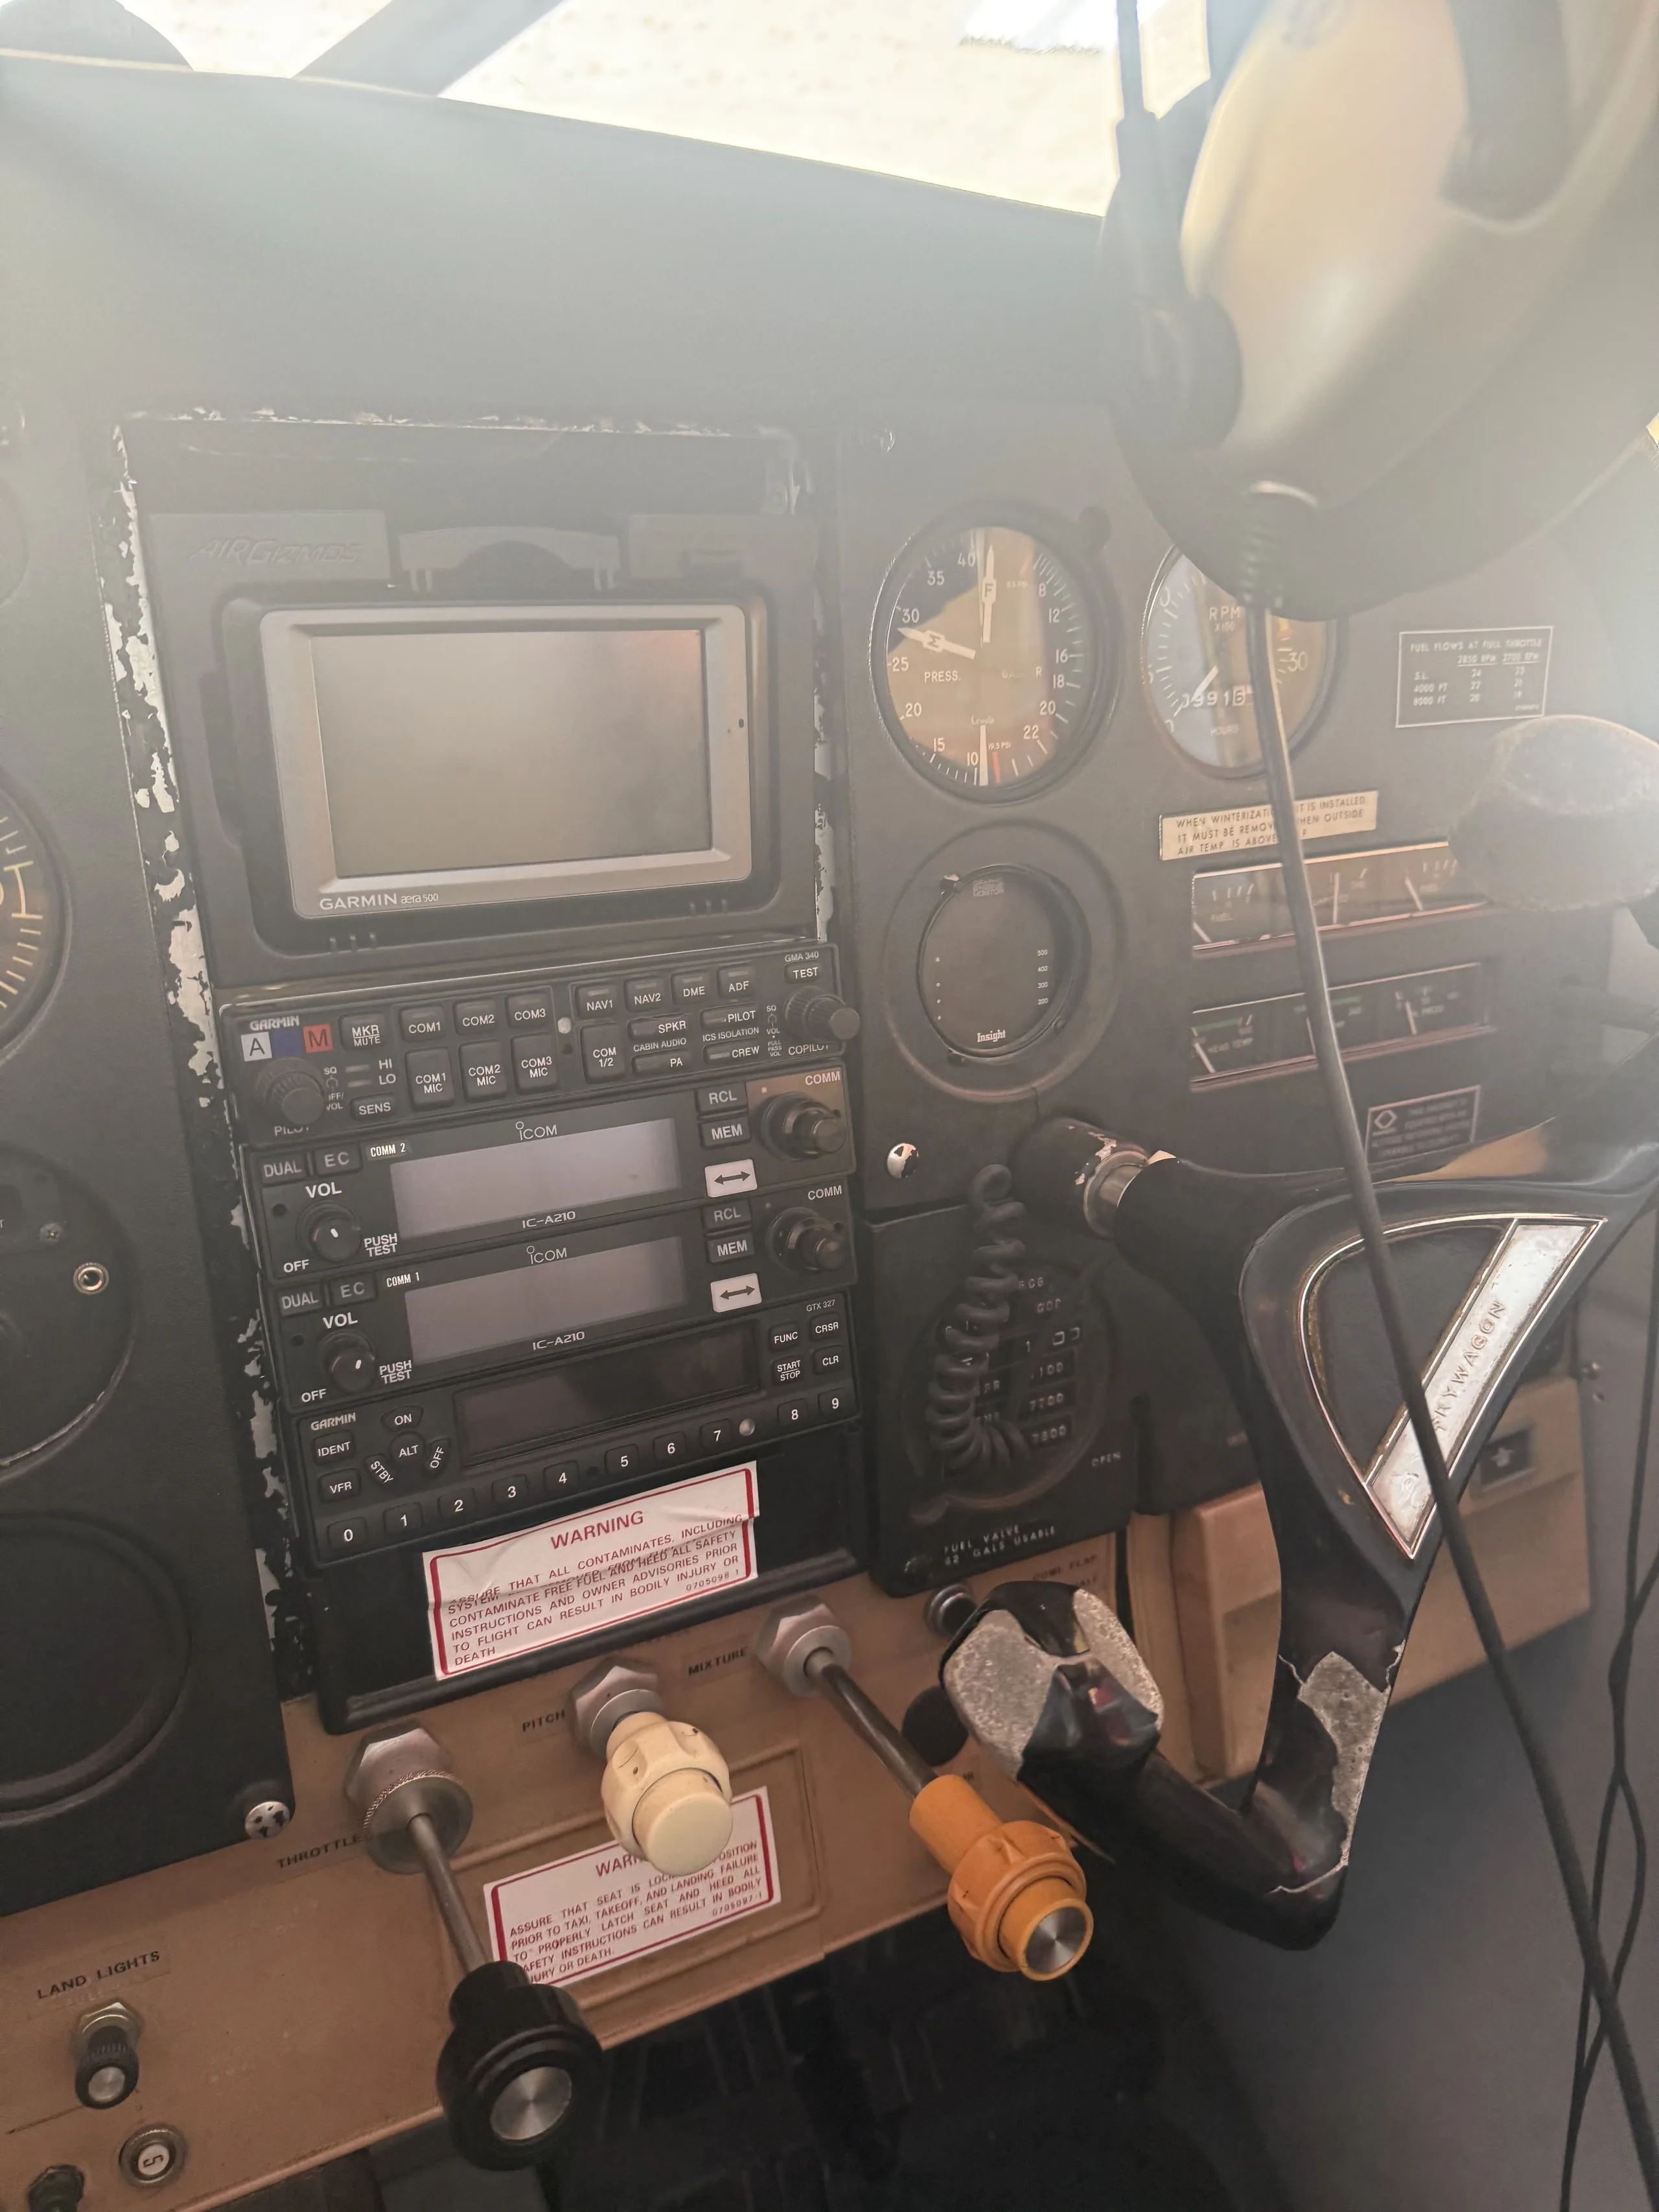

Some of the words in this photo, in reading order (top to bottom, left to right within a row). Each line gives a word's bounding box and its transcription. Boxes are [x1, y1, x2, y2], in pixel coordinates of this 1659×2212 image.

[957, 553, 975, 568] 40
[927, 570, 945, 586] 35
[1038, 584, 1047, 597] 8
[901, 608, 920, 623] 30
[1049, 609, 1060, 623] 12
[1434, 641, 1463, 652] FLOWS
[1056, 649, 1068, 663] 16
[1289, 650, 1308, 672] 30
[892, 657, 909, 672] 25
[1052, 674, 1065, 688] 18
[905, 703, 922, 717] 20
[1039, 701, 1056, 716] 20
[1023, 725, 1039, 740] 22
[933, 738, 946, 752] 15
[967, 752, 979, 766] 10
[1320, 796, 1365, 810] INSTALLED
[1176, 817, 1206, 828] WHEN
[1324, 809, 1363, 822] OUTSIDE
[1178, 833, 1187, 843] IT
[1192, 830, 1219, 841] MUST
[1224, 827, 1234, 837] BE
[1178, 846, 1194, 856] AIR
[1200, 842, 1224, 852] TEMP
[1232, 839, 1240, 848] IS
[1246, 833, 1277, 846] ABOVE
[319, 893, 398, 911] GARMIN
[793, 966, 818, 980] TEST
[683, 985, 706, 997] DME
[728, 981, 749, 993] ADF
[586, 999, 614, 1012] NAV1
[634, 992, 662, 1005] NAV2
[462, 1014, 495, 1028] COM2
[515, 1008, 546, 1021] COM3
[727, 1010, 756, 1024] PILOT
[249, 1016, 299, 1031] GARMIN
[352, 1024, 380, 1037] MKR
[408, 1021, 441, 1034] COM1
[658, 1019, 687, 1034] SPKR
[354, 1036, 381, 1047] MUTE
[702, 1032, 717, 1042] ICS
[718, 1027, 760, 1040] ISOLATION
[977, 1029, 1006, 1043] Insight
[592, 1046, 617, 1058] COM
[633, 1041, 661, 1053] CABIN
[662, 1037, 687, 1049] AUDIO
[732, 1045, 760, 1058] CREW
[378, 1058, 393, 1070] HI
[521, 1056, 553, 1069] COM3
[599, 1056, 614, 1068] 1/2
[669, 1057, 683, 1068] PA
[469, 1064, 501, 1077] COM2
[529, 1066, 549, 1078] MIC
[378, 1073, 396, 1085] LO
[415, 1073, 447, 1086] COM1
[476, 1075, 496, 1086] MIC
[805, 1071, 841, 1087] COMM
[424, 1082, 443, 1094] MIC
[708, 1089, 738, 1106] RCL
[359, 1102, 391, 1115] SENS
[712, 1123, 743, 1141] MEM
[370, 1145, 397, 1158] COMM
[263, 1159, 303, 1178] DUAL
[305, 1182, 342, 1199] VOL
[807, 1184, 843, 1201] COMM
[522, 1211, 576, 1229] IC-A210
[713, 1206, 742, 1223] RCL
[363, 1233, 399, 1248] PUSH
[365, 1242, 398, 1258] TEST
[717, 1239, 748, 1258] MEM
[283, 1259, 310, 1274] OFF
[386, 1274, 412, 1288] COMM
[281, 1290, 319, 1310] DUAL
[806, 1302, 822, 1312] GTX
[323, 1311, 358, 1330] VOL
[815, 1321, 839, 1334] CRSR
[532, 1330, 585, 1351] IC-A210
[773, 1331, 798, 1345] FUNC
[378, 1359, 412, 1375] PUSH
[777, 1360, 801, 1373] START
[822, 1355, 840, 1367] CLR
[382, 1369, 412, 1385] TEST
[780, 1369, 801, 1382] STOP
[301, 1388, 327, 1403] OFF
[310, 1412, 356, 1432] GARMIN
[394, 1414, 412, 1426] ON
[317, 1441, 351, 1458] IDENT
[398, 1444, 419, 1458] ALT
[430, 1446, 445, 1469] OFF
[369, 1460, 394, 1485] STBY
[329, 1480, 353, 1495] VFR
[551, 1509, 644, 1550] WARNING
[983, 1524, 1020, 1543] VALVE
[450, 1592, 540, 1628] CONTAMINATE
[544, 1582, 573, 1599] FREE
[695, 1530, 736, 1550] SAFETY
[509, 1574, 540, 1590] THAT
[549, 1565, 570, 1579] ALL
[452, 1605, 542, 1641] INSTRUCTIONS
[550, 1595, 575, 1611] AND
[583, 1578, 626, 1600] OWNER
[632, 1555, 699, 1585] ADVISORIES
[706, 1543, 737, 1560] PRIOR
[453, 1642, 470, 1653] TO
[478, 1625, 519, 1646] FLIGHT
[527, 1615, 552, 1630] CAN
[560, 1598, 604, 1621] RESULT
[612, 1593, 623, 1604] IN
[630, 1578, 670, 1598] BODILY
[677, 1561, 717, 1582] INJURY
[723, 1555, 739, 1566] OR
[455, 1646, 496, 1666] DEATH
[688, 1645, 747, 1677] MIXTURE
[522, 1708, 566, 1733] PITCH
[277, 1832, 366, 1869] THROTTLE
[511, 1932, 543, 1951] PRIOR
[546, 1925, 561, 1937] TO
[646, 1887, 667, 1903] AND
[721, 1853, 758, 1874] FAILURE
[539, 1927, 591, 1954] PROPERLY
[601, 1912, 634, 1931] LATCH
[644, 1898, 669, 1916] SEAT
[679, 1887, 700, 1903] AND
[743, 1865, 760, 1879] ALL
[510, 1914, 552, 1938] ASSURE
[561, 1902, 588, 1918] THAT
[597, 1889, 623, 1905] SEAT
[631, 1882, 641, 1893] IS
[561, 1924, 637, 1960] INSTRUCTIONS
[643, 1913, 664, 1929] CAN
[670, 1897, 707, 1918] RESULT
[712, 1893, 723, 1903] IN
[728, 1877, 761, 1897] BODILY
[36, 1973, 87, 2000] LAND
[97, 1949, 161, 1981] LIGHTS
[559, 1961, 574, 1973] OR
